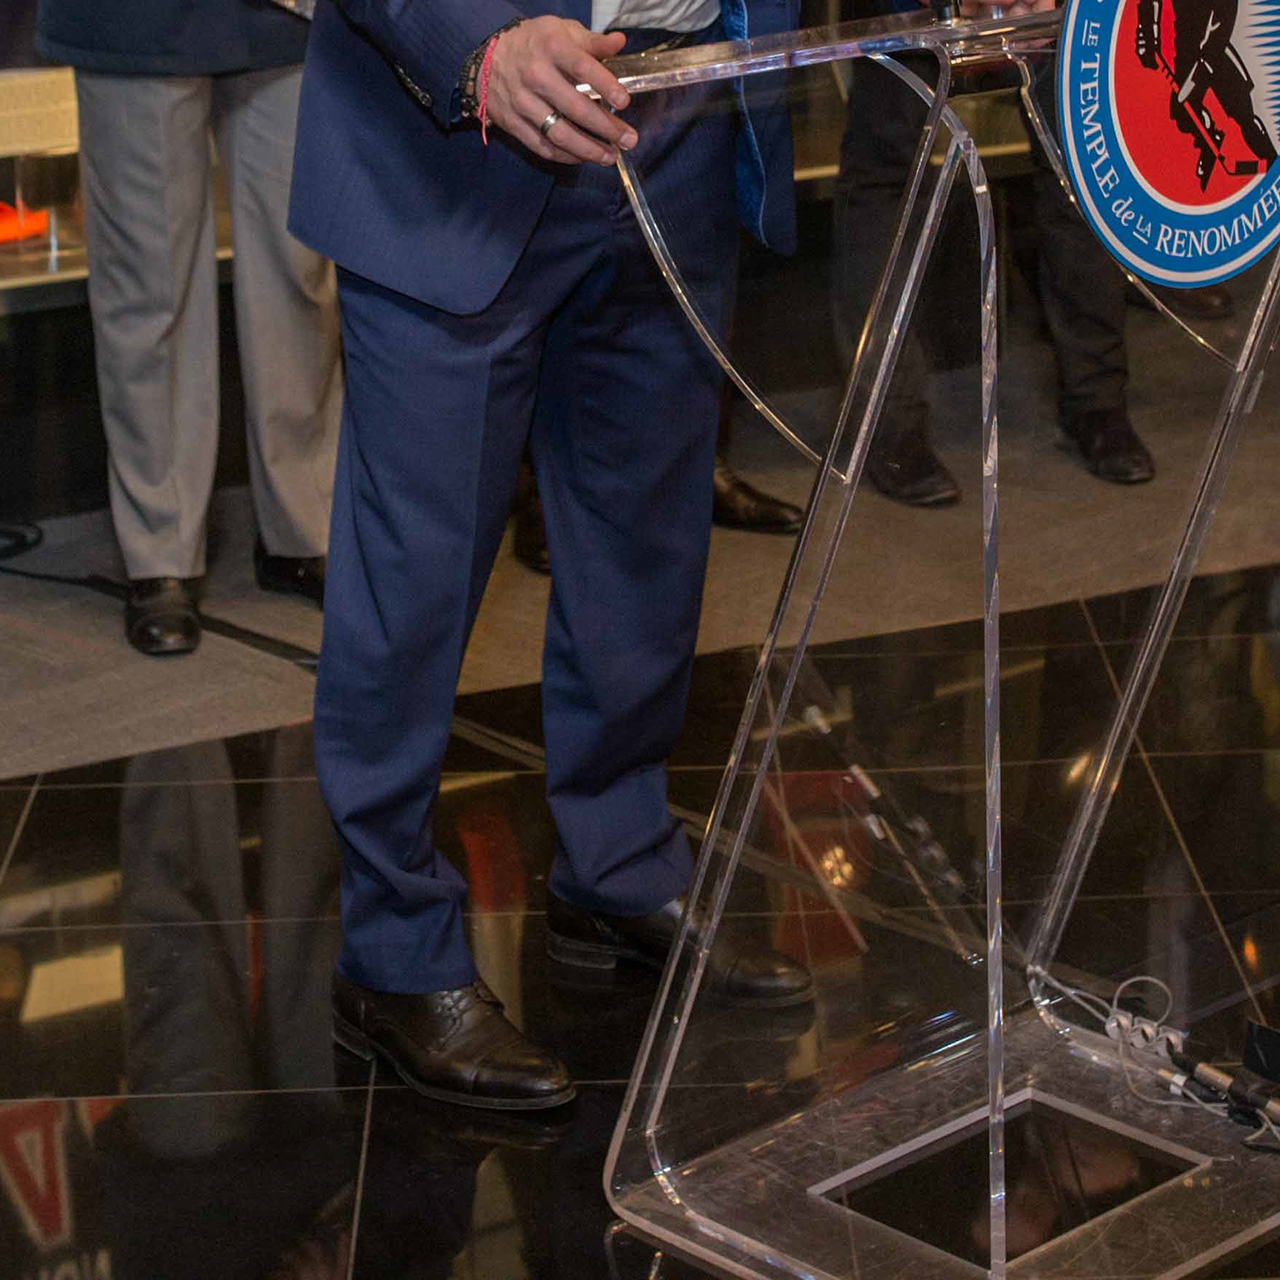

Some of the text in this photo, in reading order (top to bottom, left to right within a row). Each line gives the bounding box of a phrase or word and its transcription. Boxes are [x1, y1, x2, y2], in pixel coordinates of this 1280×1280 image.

[1084, 20, 1101, 48] LE
[1079, 52, 1121, 199] TEMPLE
[1111, 196, 1135, 228] de
[1134, 217, 1154, 241] LA
